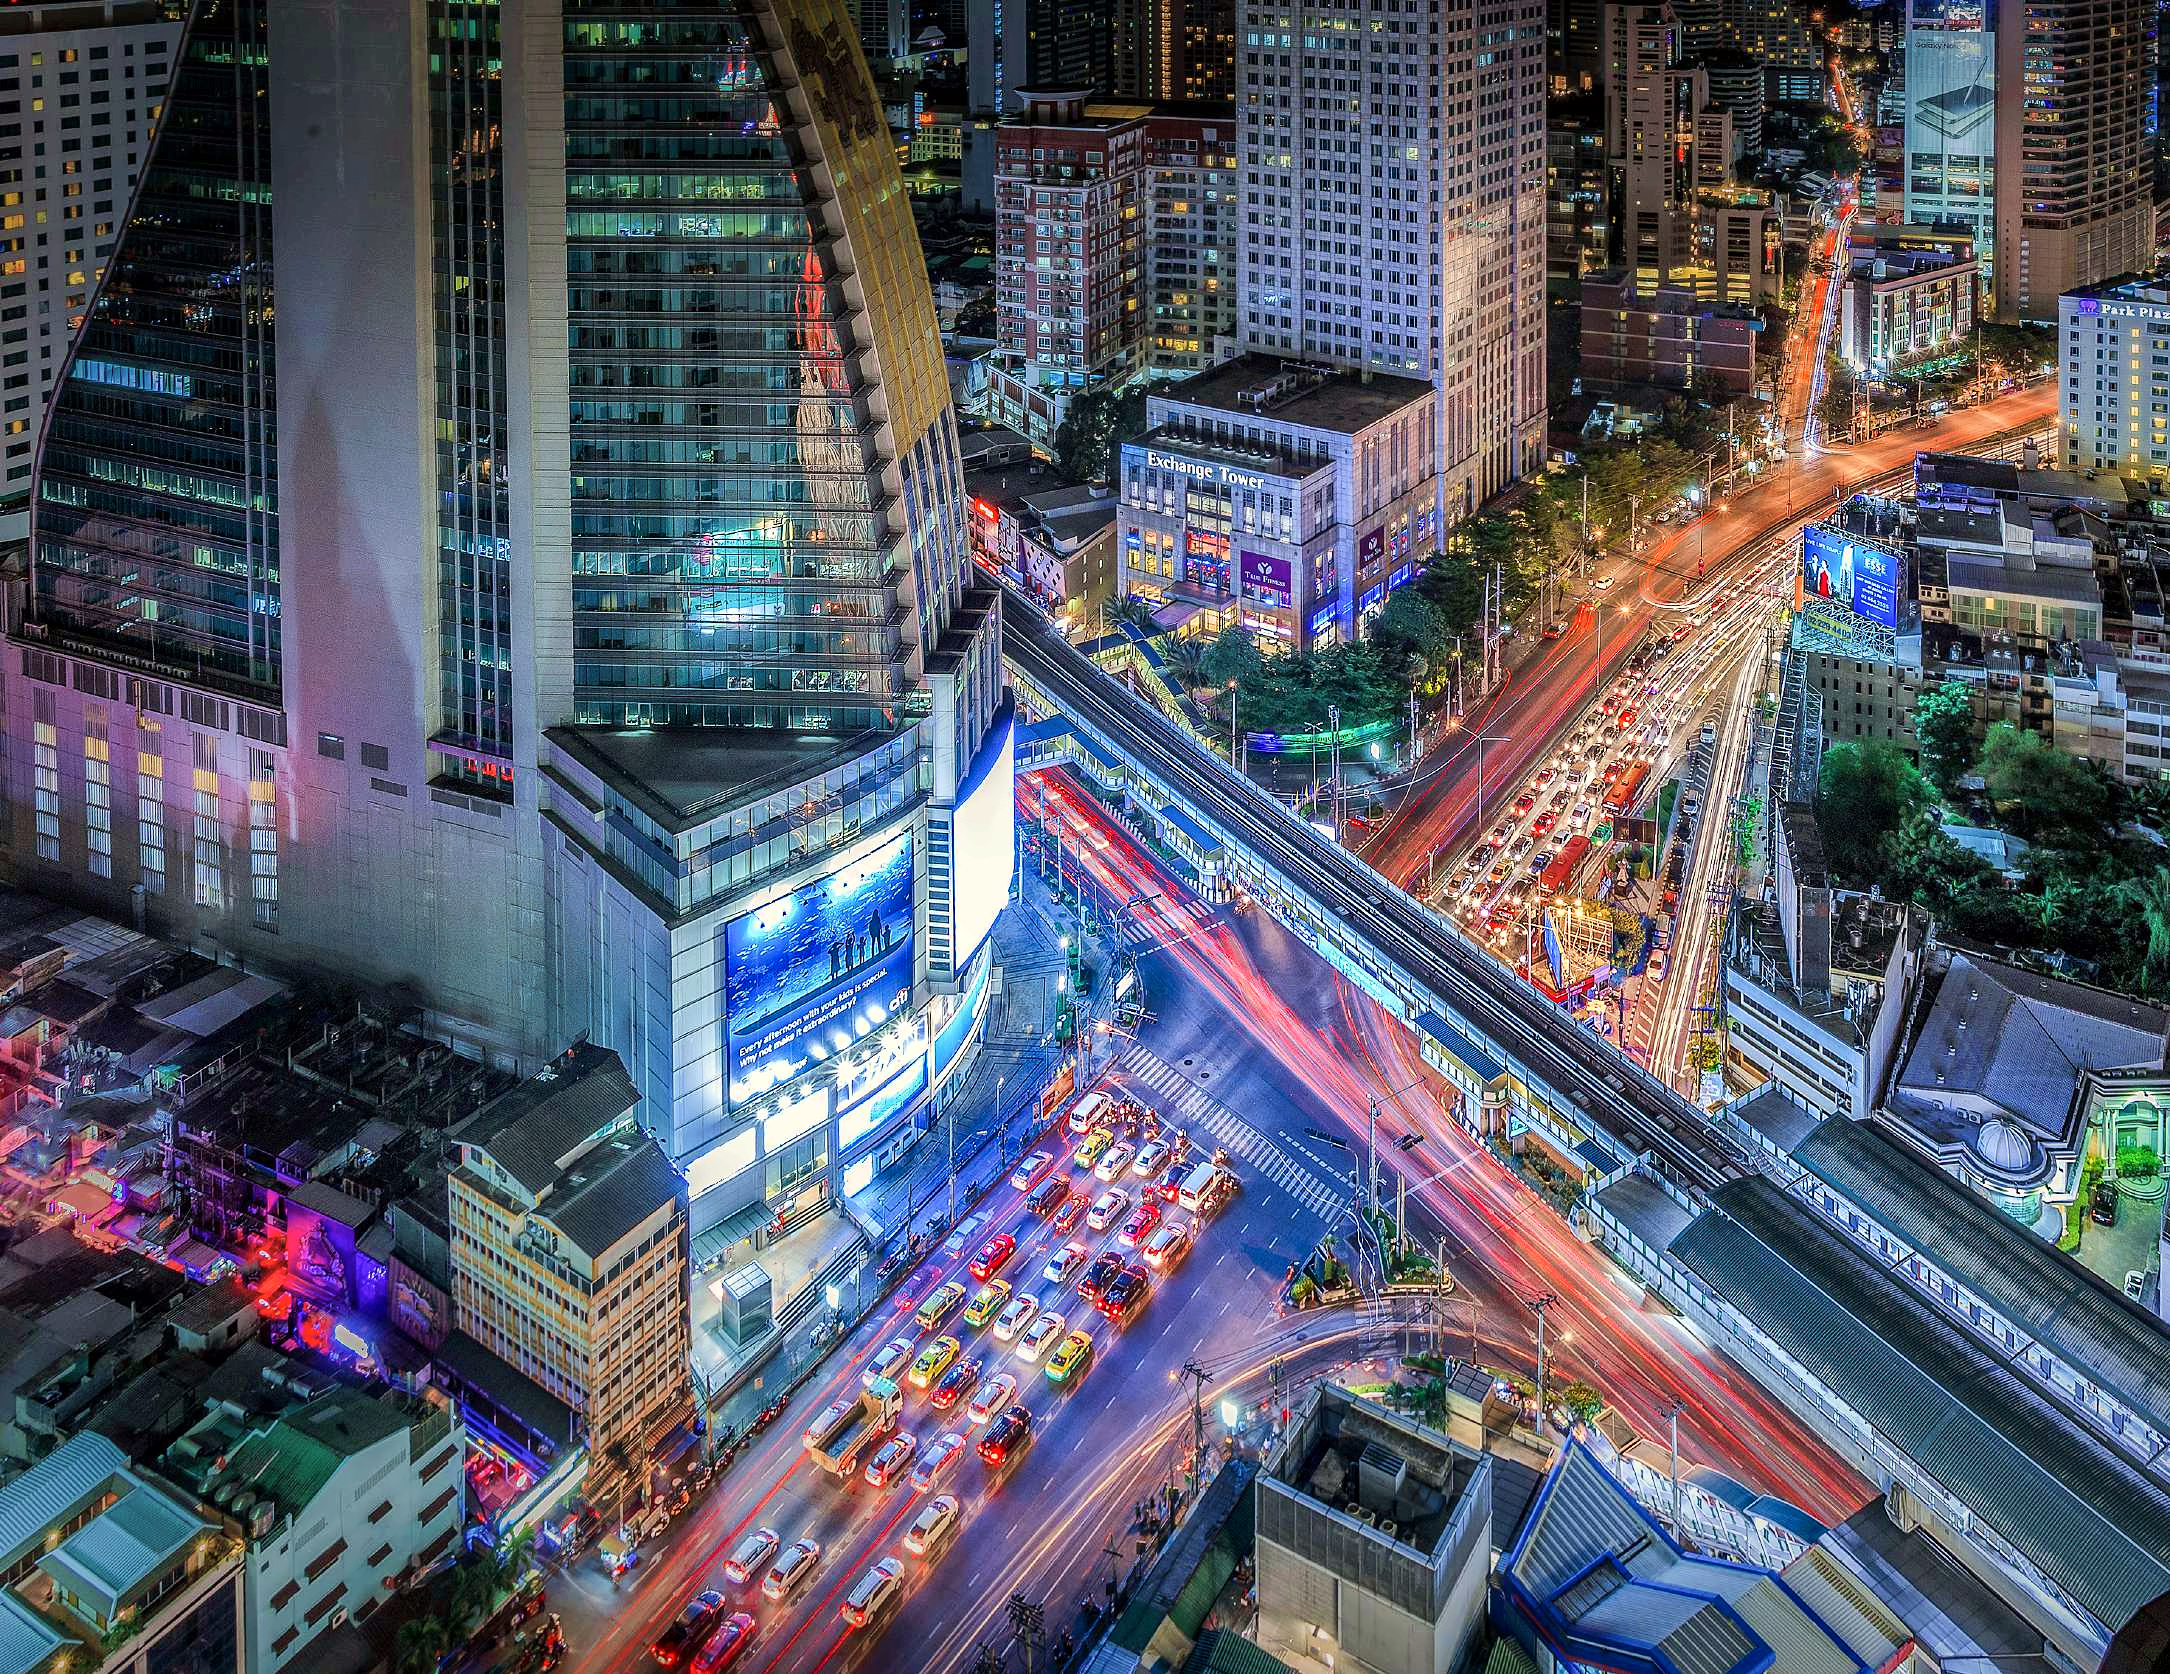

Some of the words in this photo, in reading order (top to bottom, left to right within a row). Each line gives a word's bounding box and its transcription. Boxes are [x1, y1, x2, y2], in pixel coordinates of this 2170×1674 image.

[2101, 303, 2136, 317] Park
[1147, 451, 1213, 480] Exchange
[1218, 466, 1265, 490] Tower
[739, 1039, 762, 1057] Every
[763, 1019, 803, 1044] afternoon
[802, 1007, 820, 1023] with
[820, 998, 838, 1015] your
[838, 987, 854, 1003] kids
[854, 983, 862, 993] is
[862, 968, 888, 989] special.
[889, 989, 909, 1012] citi
[739, 1052, 758, 1069] Why
[759, 1044, 773, 1058] not
[773, 1034, 795, 1053] make
[796, 1026, 803, 1038] it
[803, 996, 857, 1034] extraordinary?
